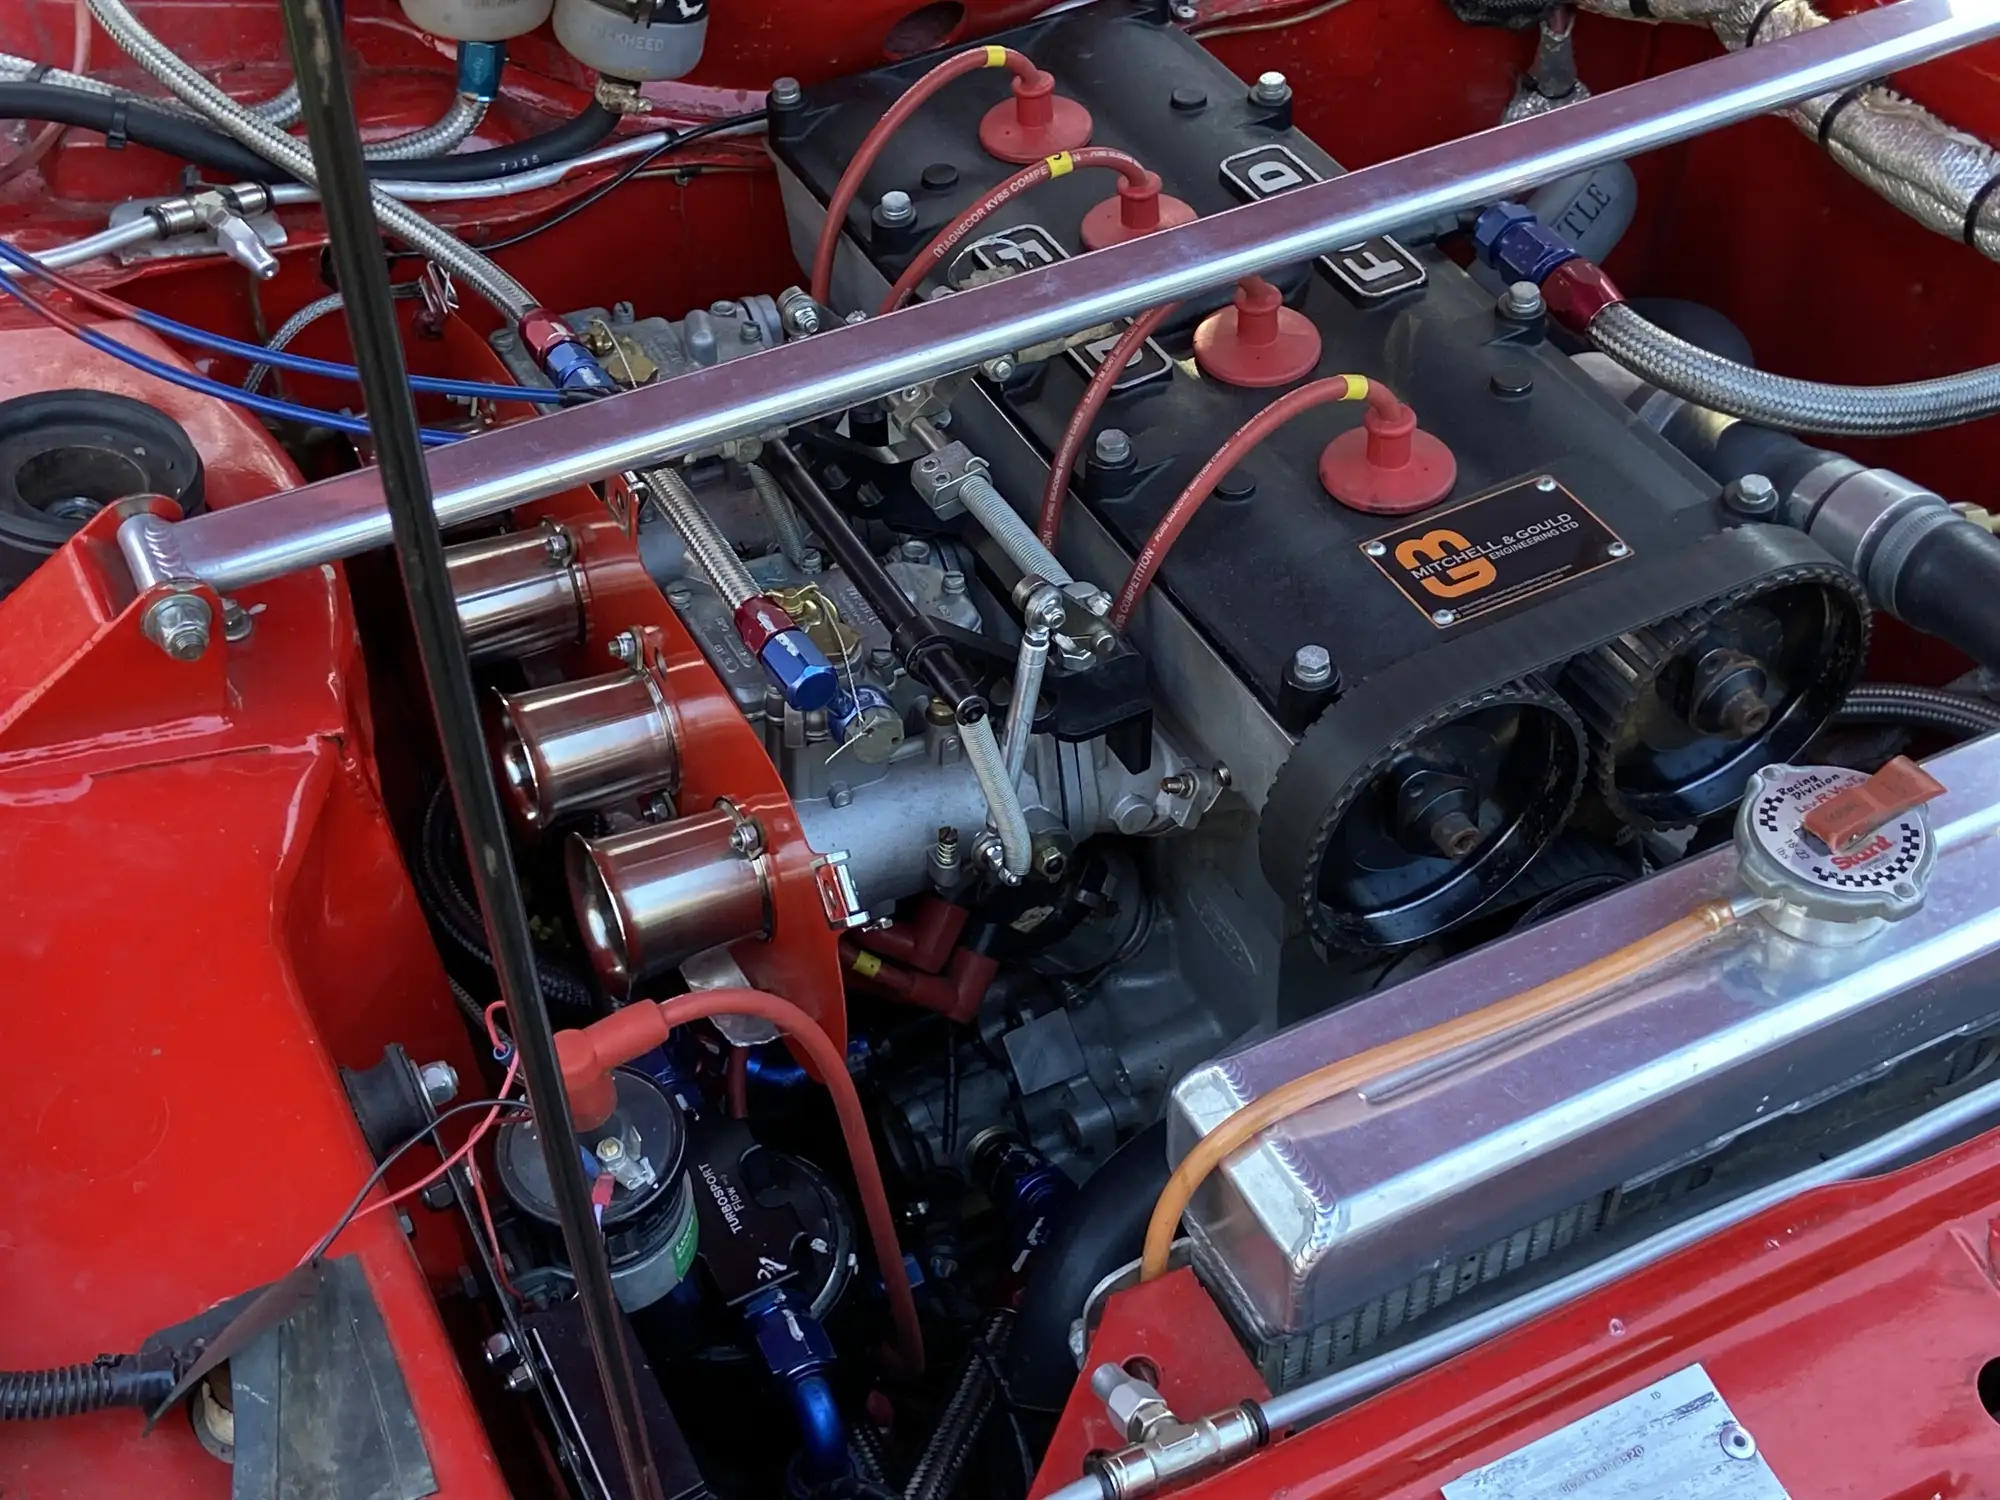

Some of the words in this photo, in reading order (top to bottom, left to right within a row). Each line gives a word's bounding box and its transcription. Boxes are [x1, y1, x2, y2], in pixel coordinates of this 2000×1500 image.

[933, 208, 987, 258] MAGNECOR
[1555, 182, 1611, 240] TLE
[1119, 546, 1155, 613] COMPETITION
[1154, 521, 1170, 543] PURE
[1165, 490, 1190, 524] SILICONE
[1410, 540, 1503, 580] MITCHELL
[1502, 534, 1516, 545] &
[1515, 512, 1572, 540] GOULD
[1488, 527, 1560, 561] ENGINEERING
[1558, 521, 1580, 534] LTD
[1776, 774, 1818, 797] Racing
[1791, 773, 1840, 800] Division
[698, 1163, 743, 1235] TURBOSPORT
